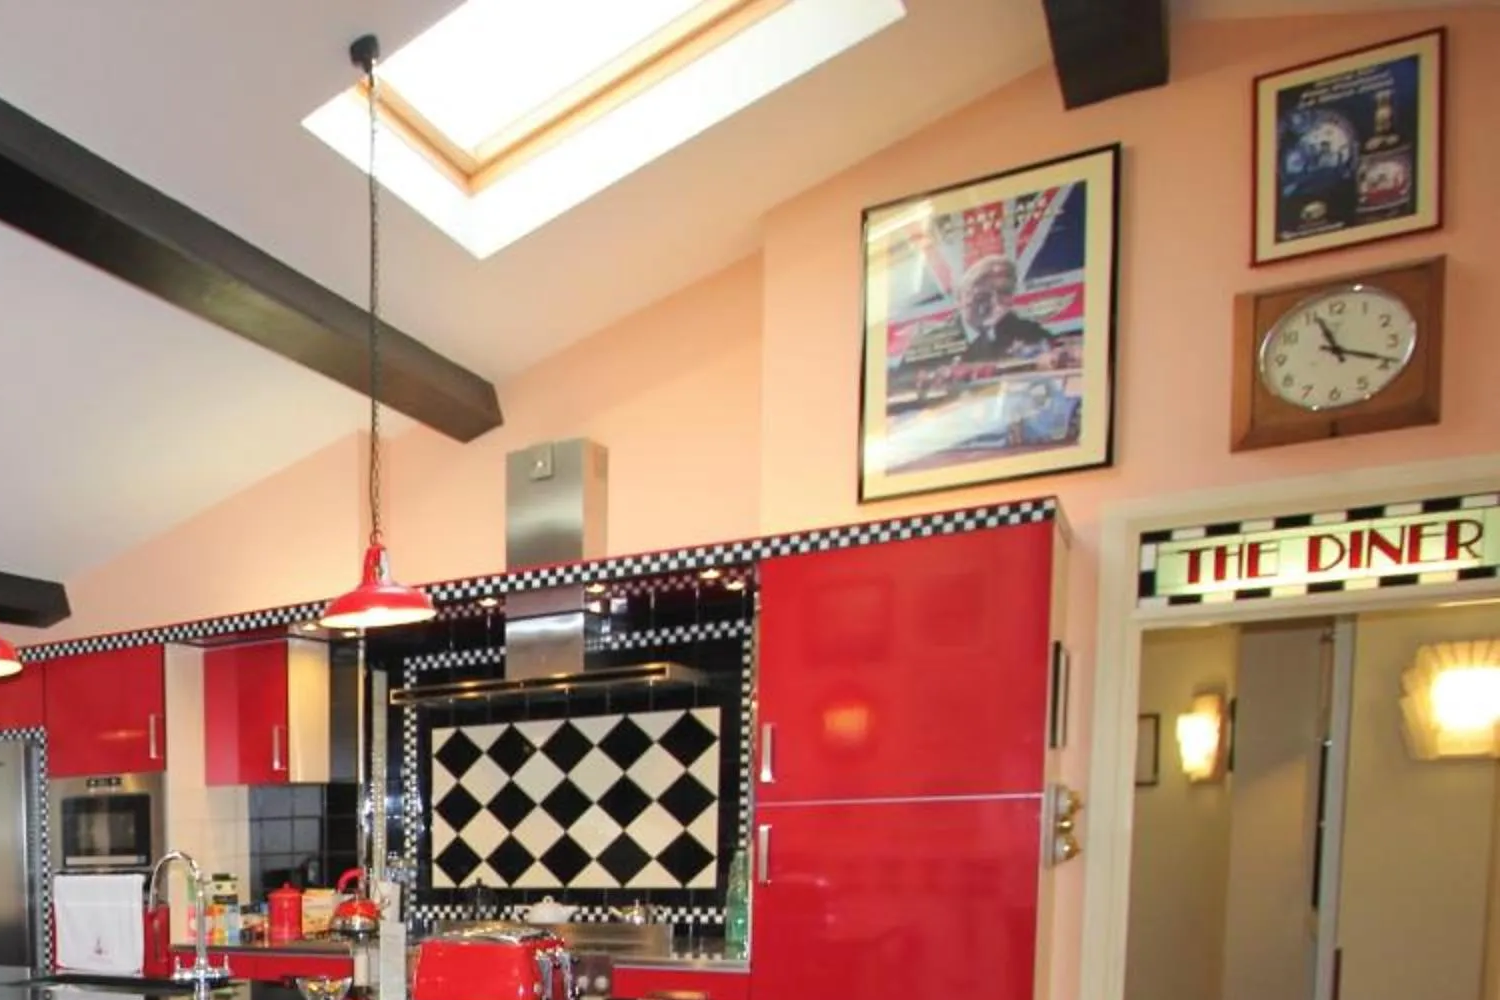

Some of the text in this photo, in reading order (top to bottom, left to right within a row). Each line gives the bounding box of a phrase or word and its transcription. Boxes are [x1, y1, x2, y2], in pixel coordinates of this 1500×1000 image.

[1329, 301, 1345, 315] 12
[1283, 330, 1299, 345] 10
[1176, 518, 1485, 584] THE DINER
